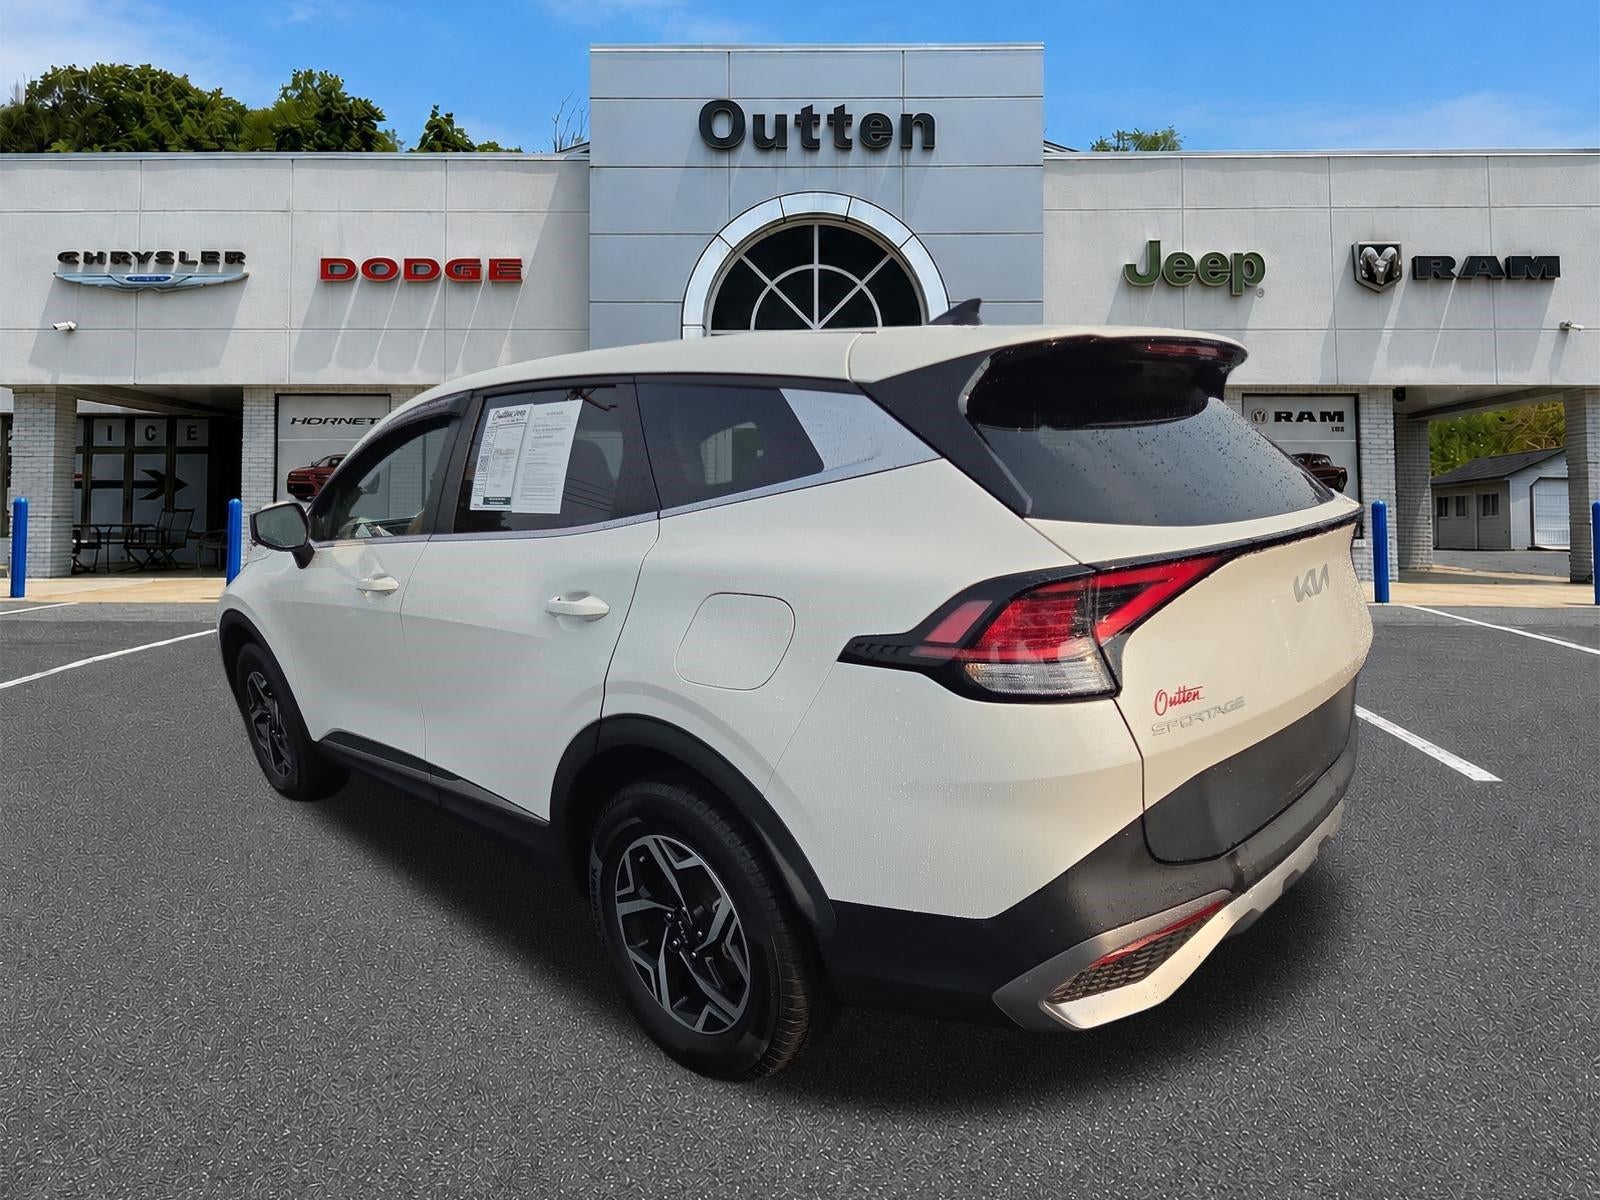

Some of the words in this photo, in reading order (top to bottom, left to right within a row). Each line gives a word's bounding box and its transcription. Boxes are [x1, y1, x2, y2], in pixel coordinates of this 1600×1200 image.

[699, 98, 936, 151] Outten
[57, 251, 246, 265] CHRYSLER
[320, 257, 523, 283] DODGE
[1123, 239, 1266, 296] Jeep
[1411, 255, 1561, 280] RAM
[290, 417, 381, 425] HORNET
[1274, 411, 1345, 422] RAM
[1154, 685, 1206, 716] Outten
[1151, 696, 1247, 736] SPORTAGE
